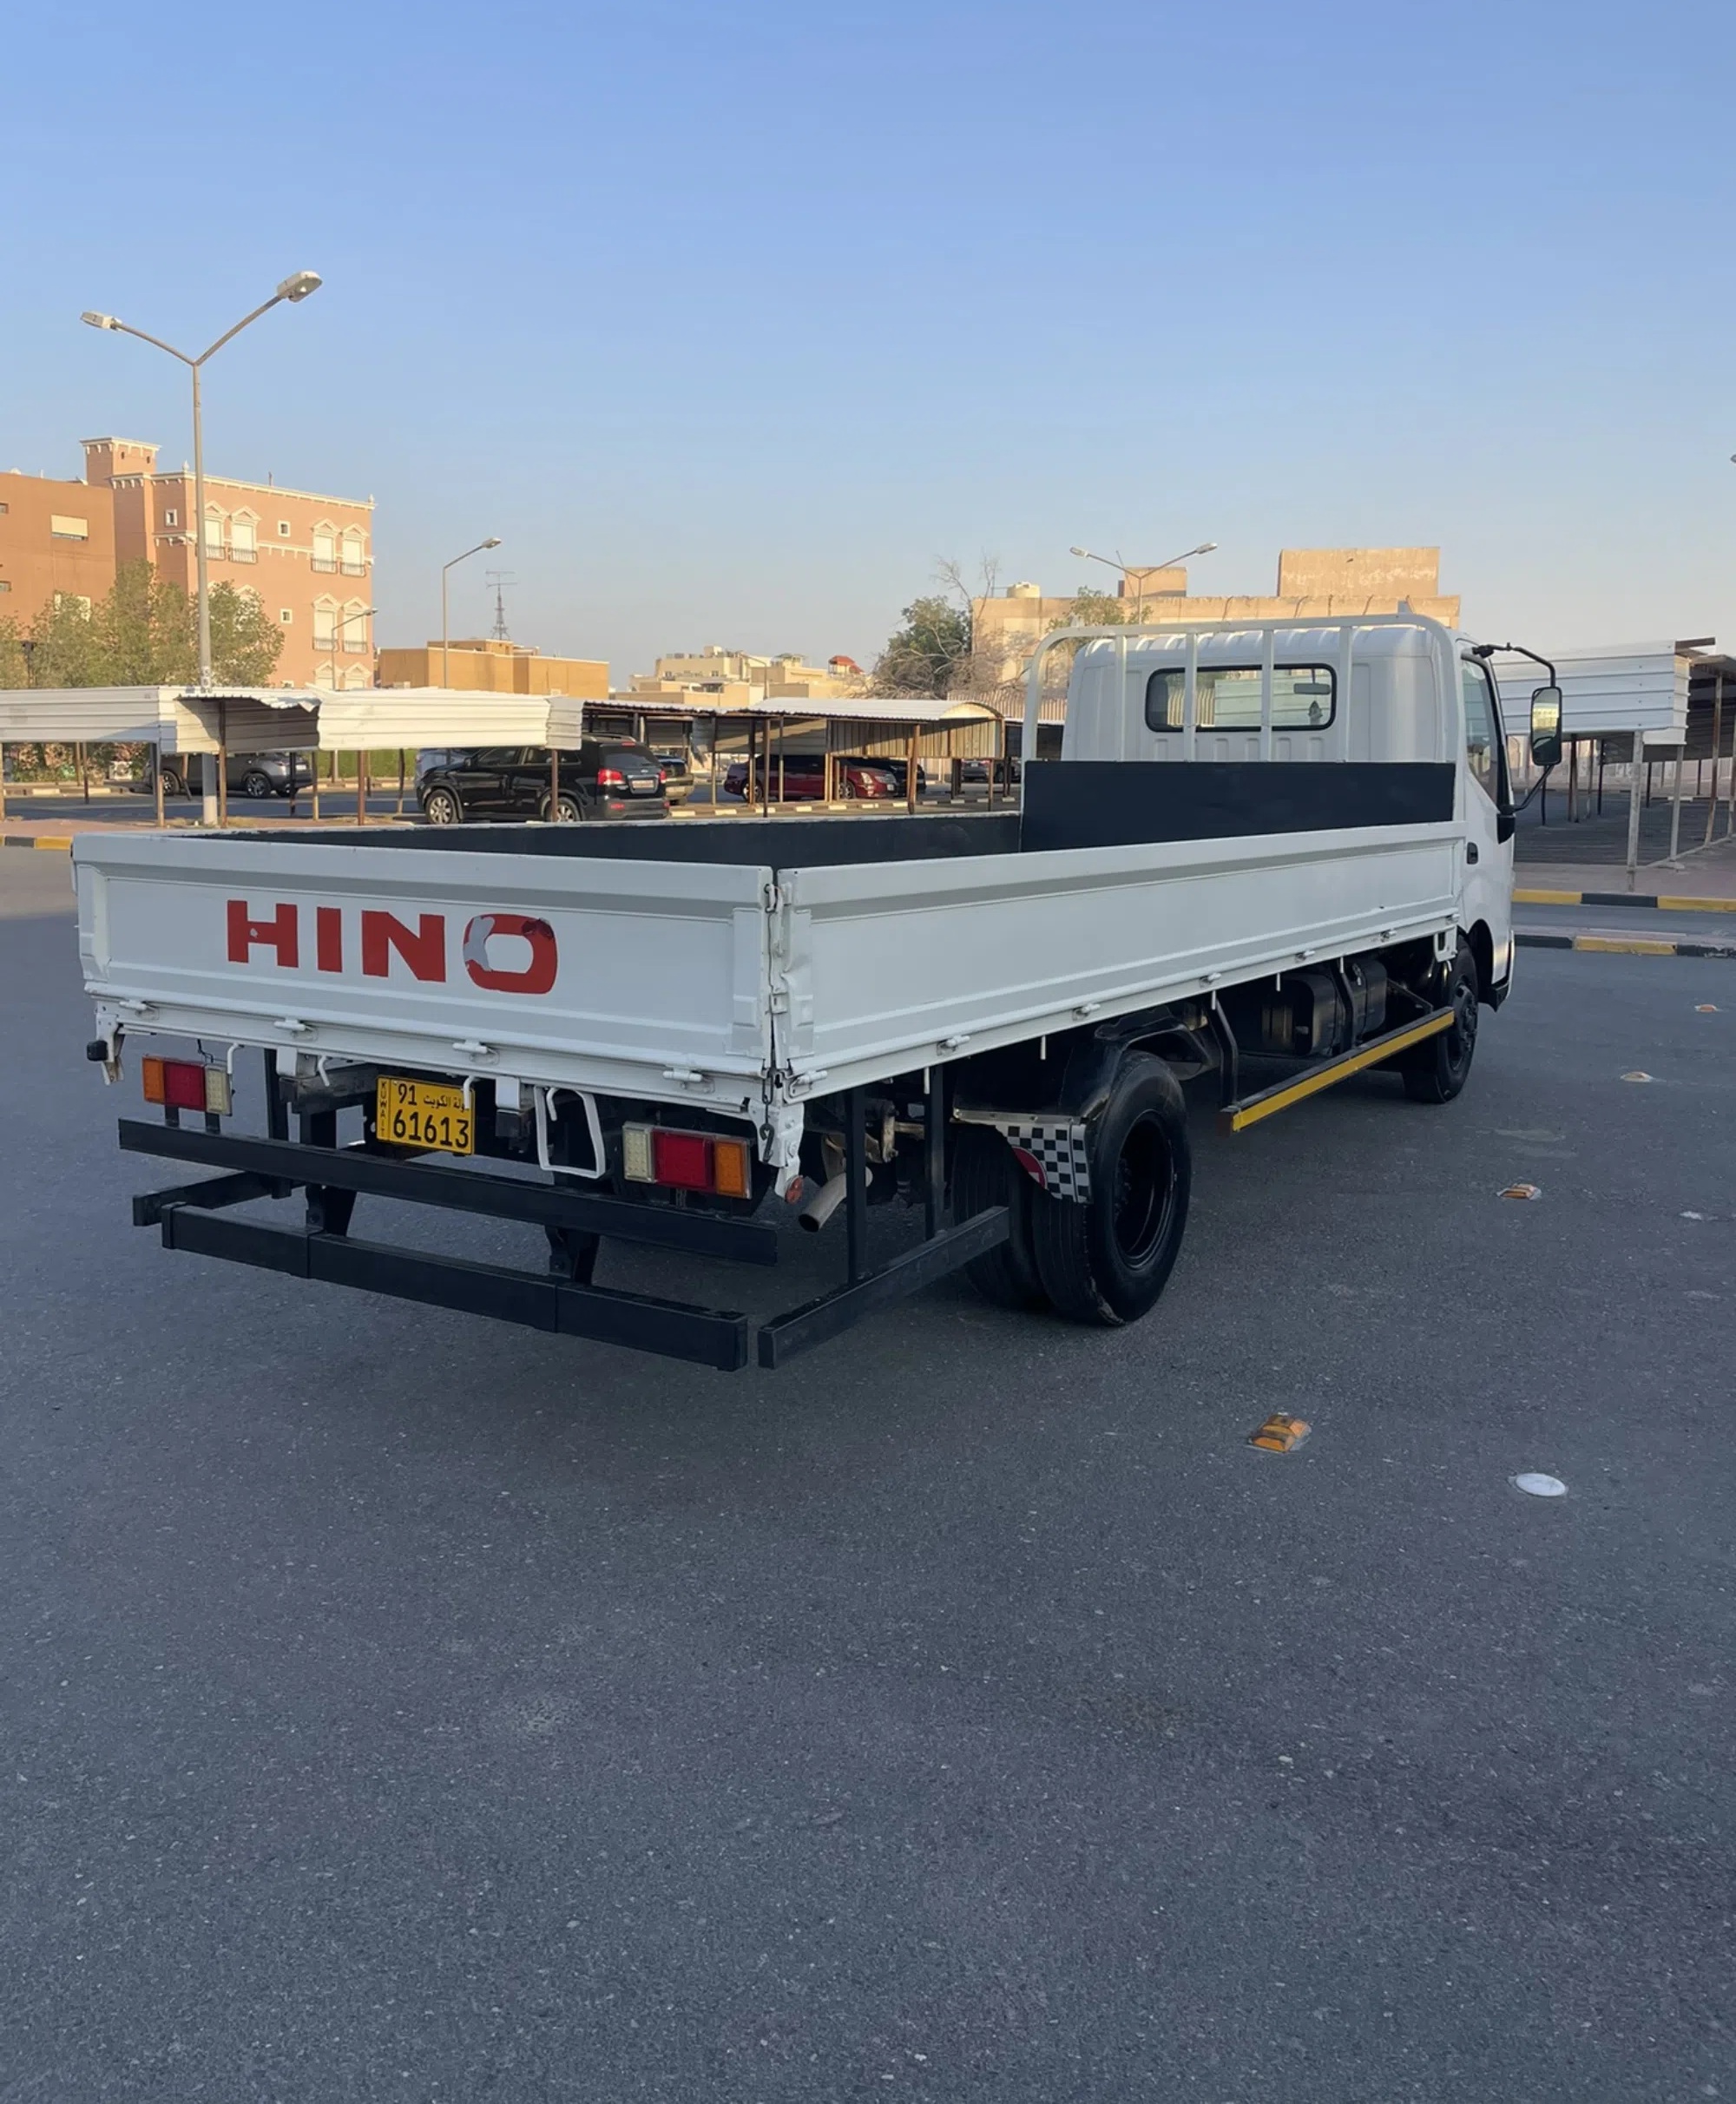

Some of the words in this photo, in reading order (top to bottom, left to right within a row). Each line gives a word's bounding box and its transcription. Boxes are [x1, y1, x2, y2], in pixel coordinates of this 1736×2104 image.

[227, 899, 558, 995] HINO
[398, 1083, 418, 1106] 91
[424, 1095, 451, 1109] الكويت
[393, 1109, 469, 1148] 61613
